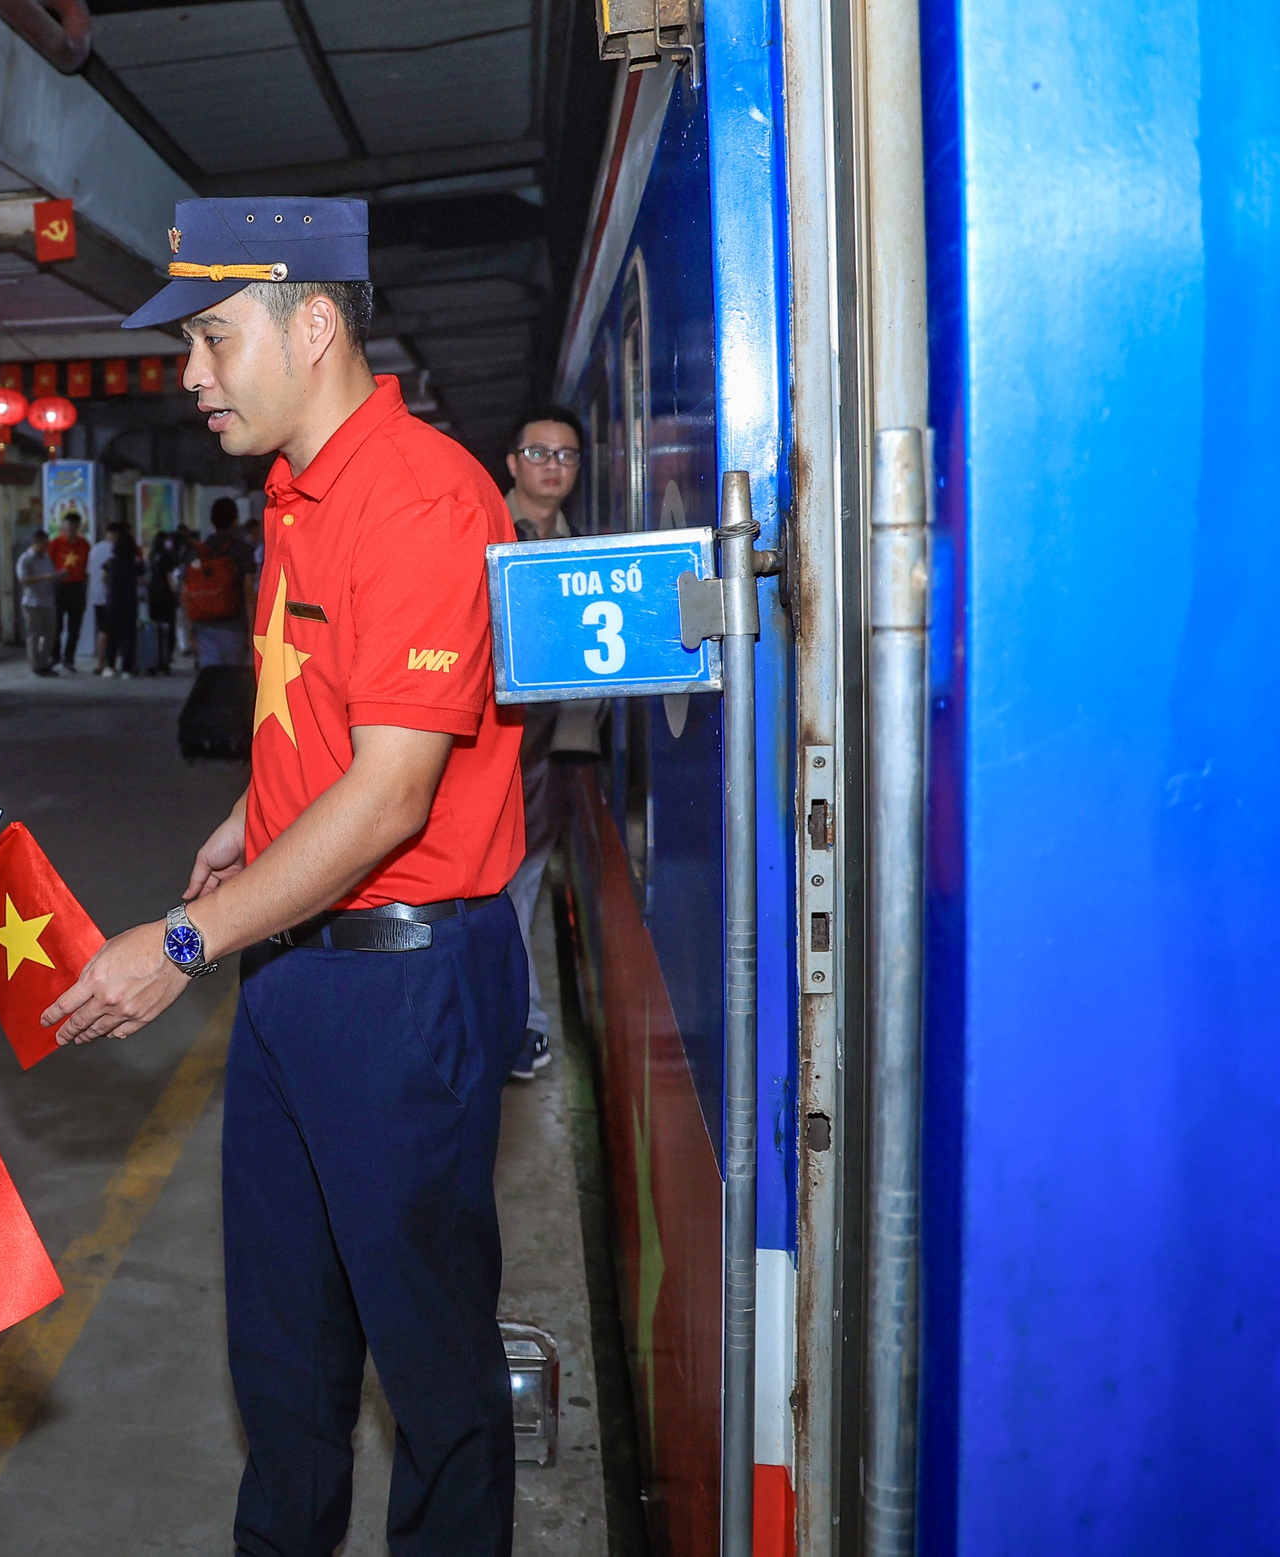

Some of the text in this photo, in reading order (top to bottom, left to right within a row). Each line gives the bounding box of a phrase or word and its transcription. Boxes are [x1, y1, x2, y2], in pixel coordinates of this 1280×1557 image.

[558, 559, 643, 597] TOA SỐ
[582, 600, 626, 675] 3
[407, 648, 460, 673] VNR
